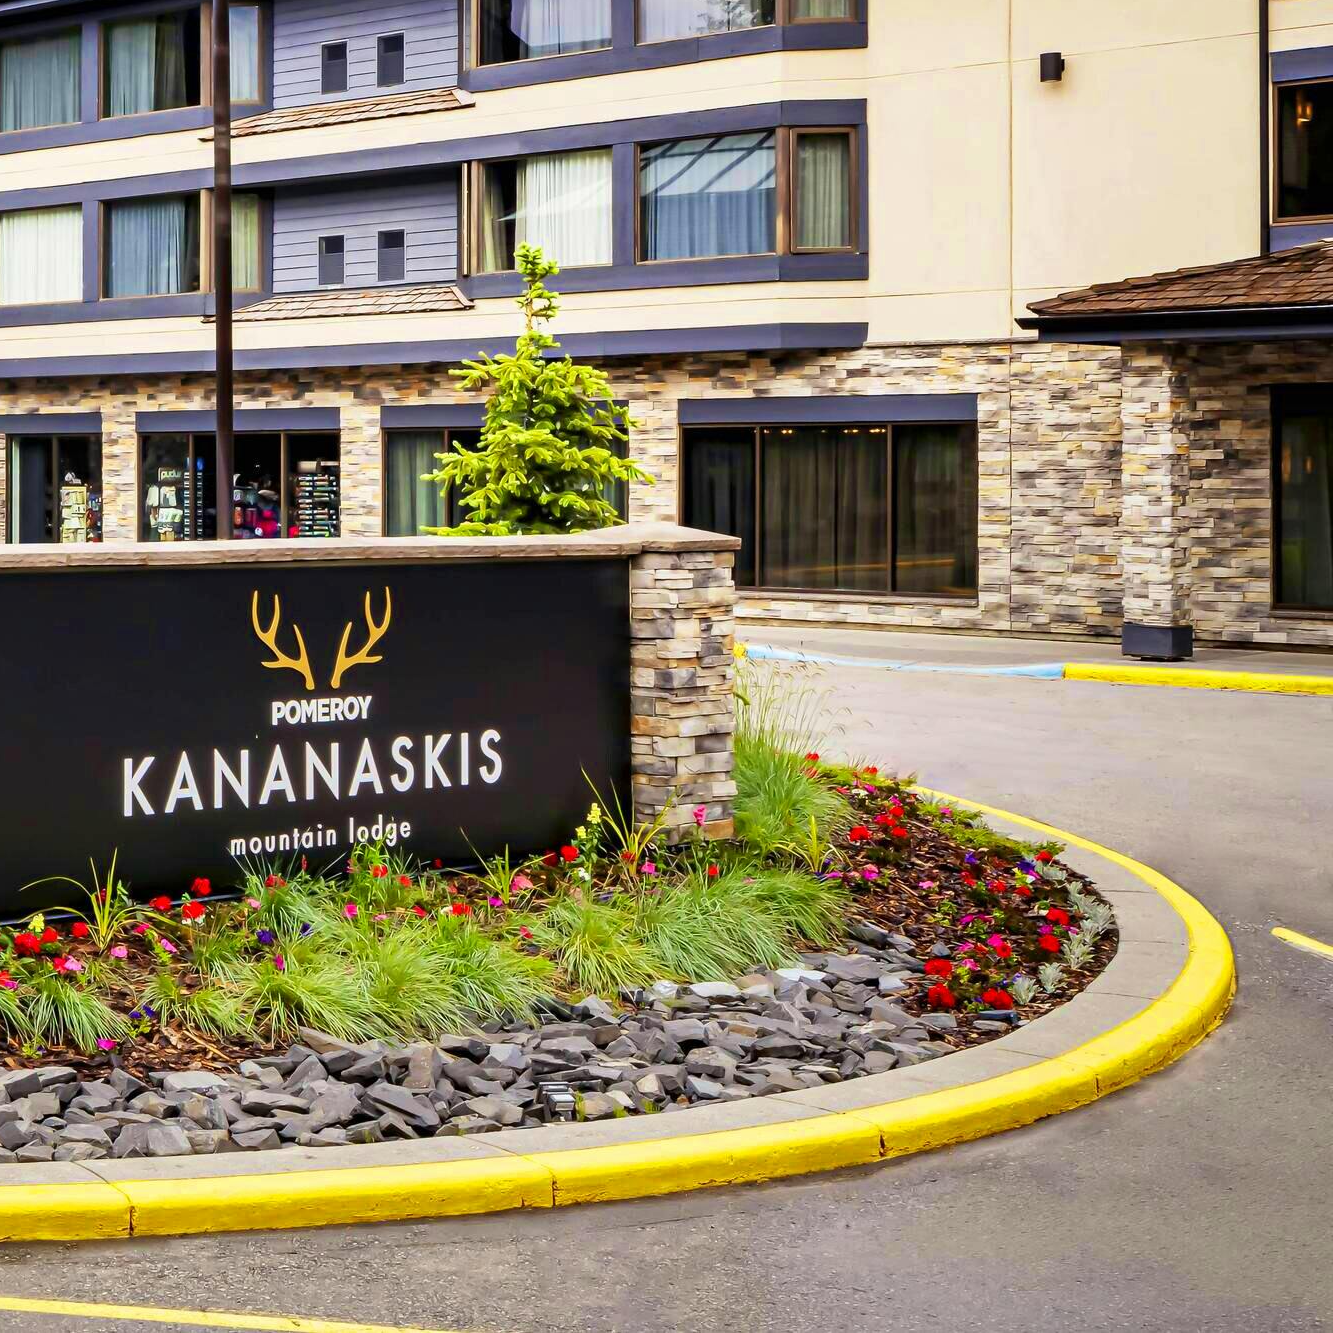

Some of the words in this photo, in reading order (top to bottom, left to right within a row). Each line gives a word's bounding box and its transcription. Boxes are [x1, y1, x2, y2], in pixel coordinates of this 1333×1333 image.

[271, 695, 373, 726] POMEROY
[123, 728, 503, 817] KANANASKIS
[230, 823, 337, 856] mountain
[348, 813, 411, 847] lodge
